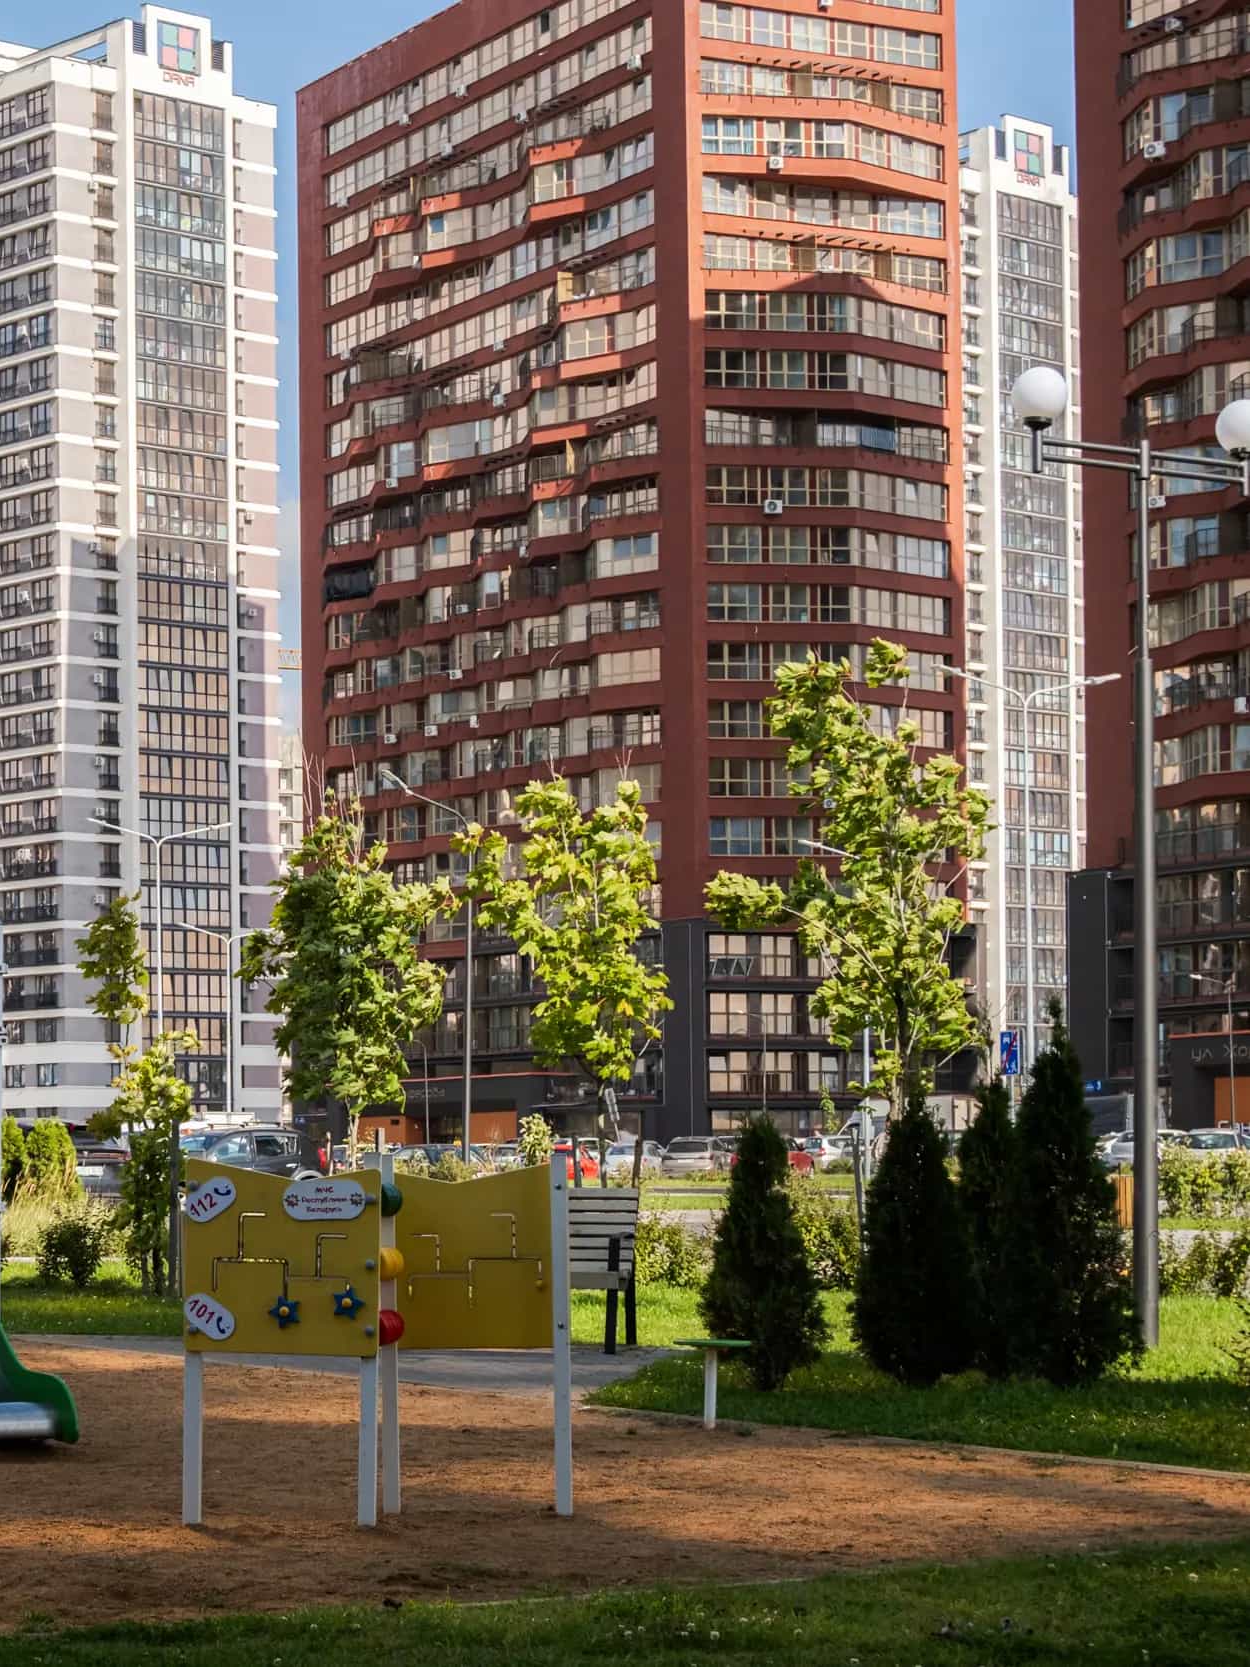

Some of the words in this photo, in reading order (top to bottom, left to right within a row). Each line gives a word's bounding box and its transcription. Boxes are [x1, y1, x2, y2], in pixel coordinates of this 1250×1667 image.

[163, 71, 195, 87] DANA
[190, 1192, 217, 1217] 112
[188, 1299, 216, 1324] 101
